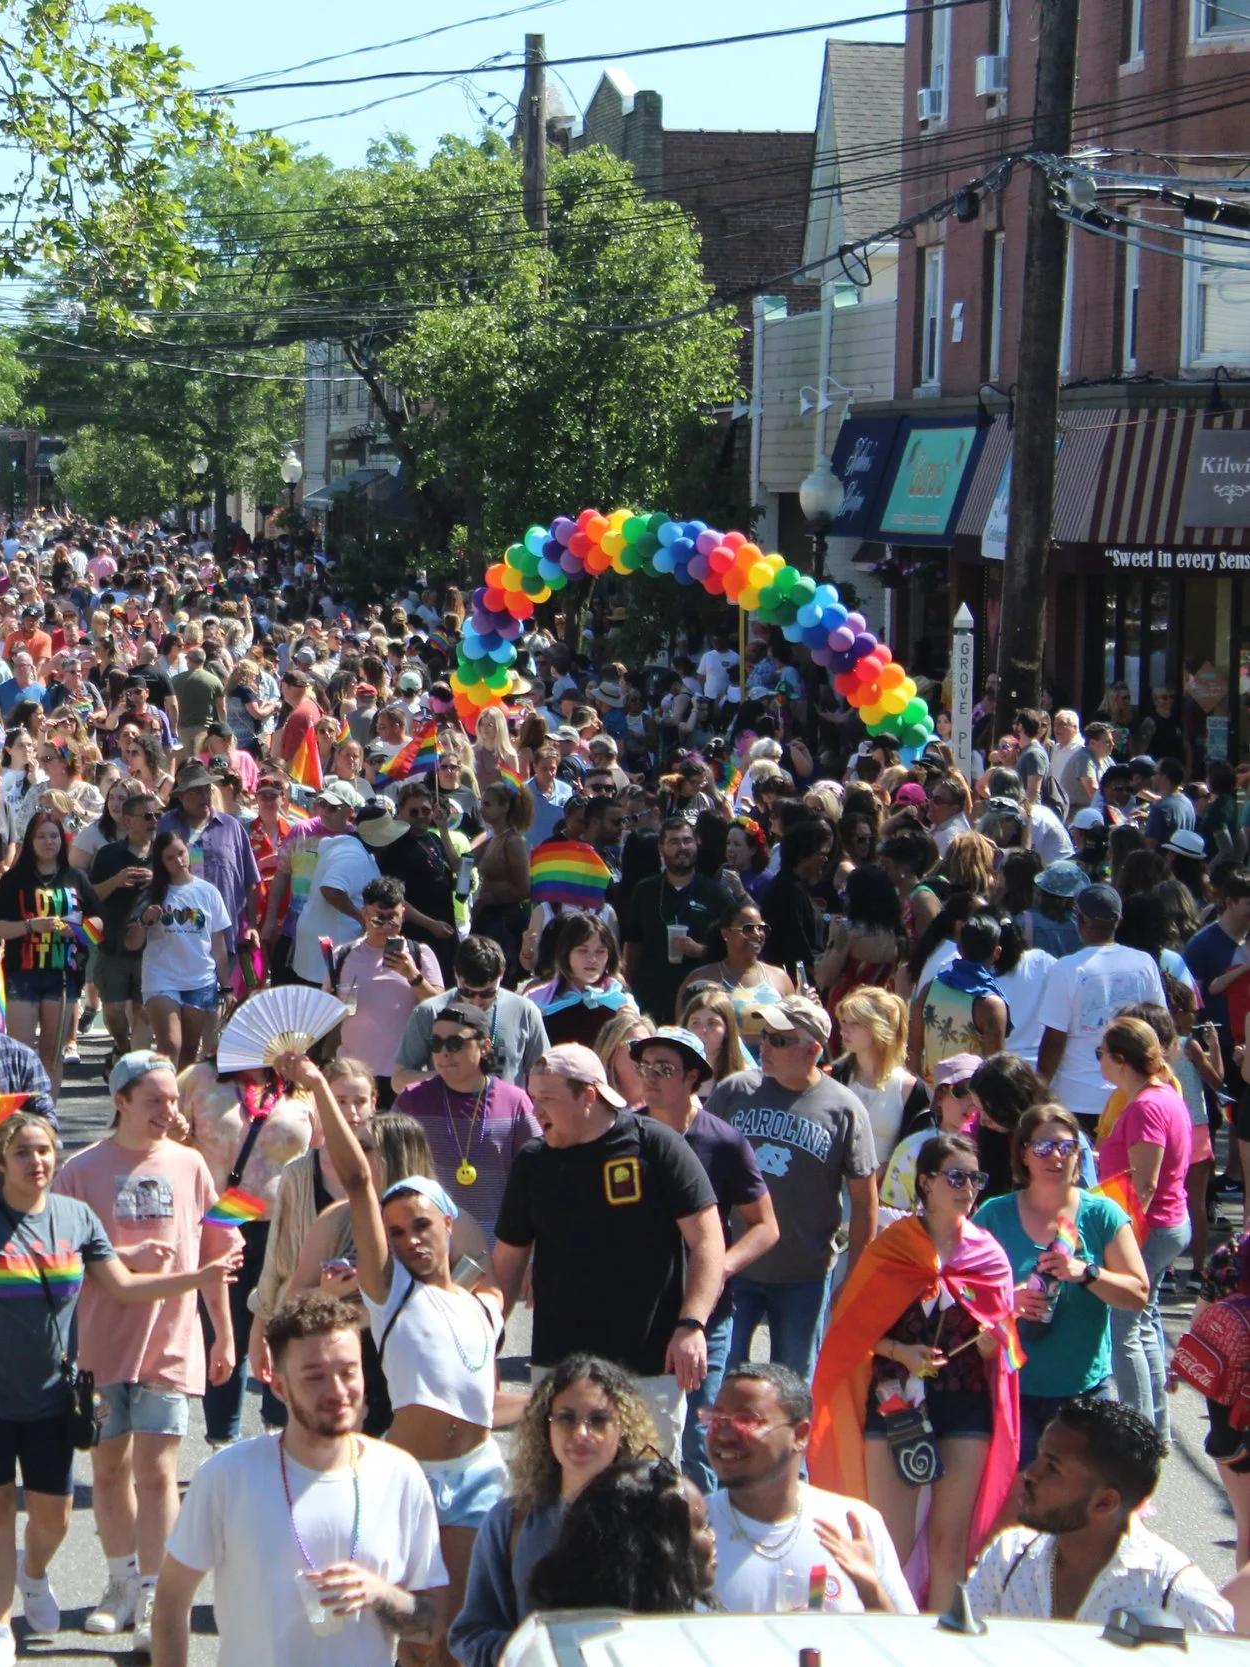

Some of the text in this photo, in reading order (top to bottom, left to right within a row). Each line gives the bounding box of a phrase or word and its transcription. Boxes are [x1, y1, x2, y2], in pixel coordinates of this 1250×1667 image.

[1199, 456, 1250, 474] Kilwi
[1157, 550, 1172, 568] in
[1176, 553, 1216, 571] every
[1219, 552, 1250, 570] Sens
[957, 642, 970, 760] GROVE PL
[18, 885, 78, 919] LOVE
[732, 1109, 833, 1163] CAROLINA
